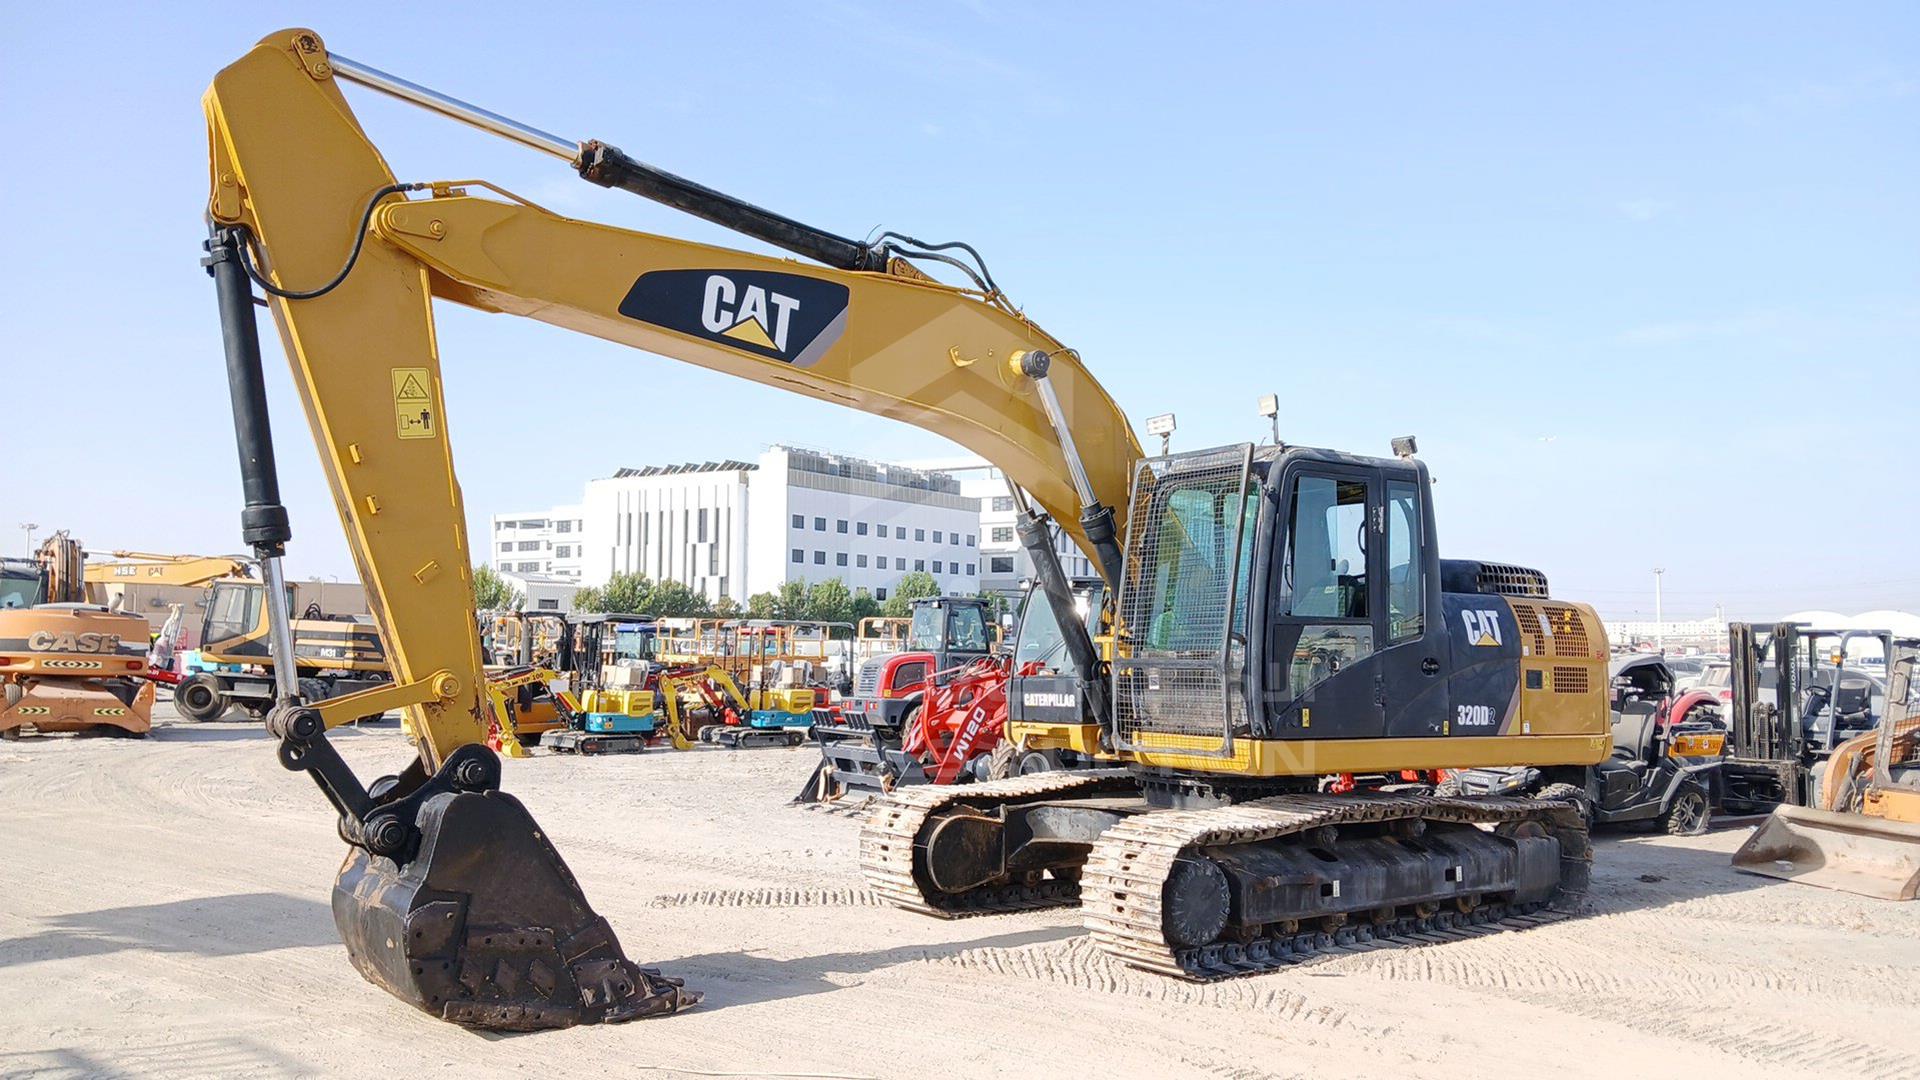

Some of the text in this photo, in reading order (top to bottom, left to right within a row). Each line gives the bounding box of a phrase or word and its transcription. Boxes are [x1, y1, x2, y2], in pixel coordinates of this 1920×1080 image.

[701, 274, 800, 353] CAT
[148, 567, 164, 577] CAT
[1461, 609, 1502, 646] CAT
[28, 630, 120, 653] CASE
[532, 672, 544, 681] 100
[1023, 693, 1076, 708] CATERPILLAR
[1457, 704, 1496, 726] 320D2
[953, 706, 986, 761] W120
